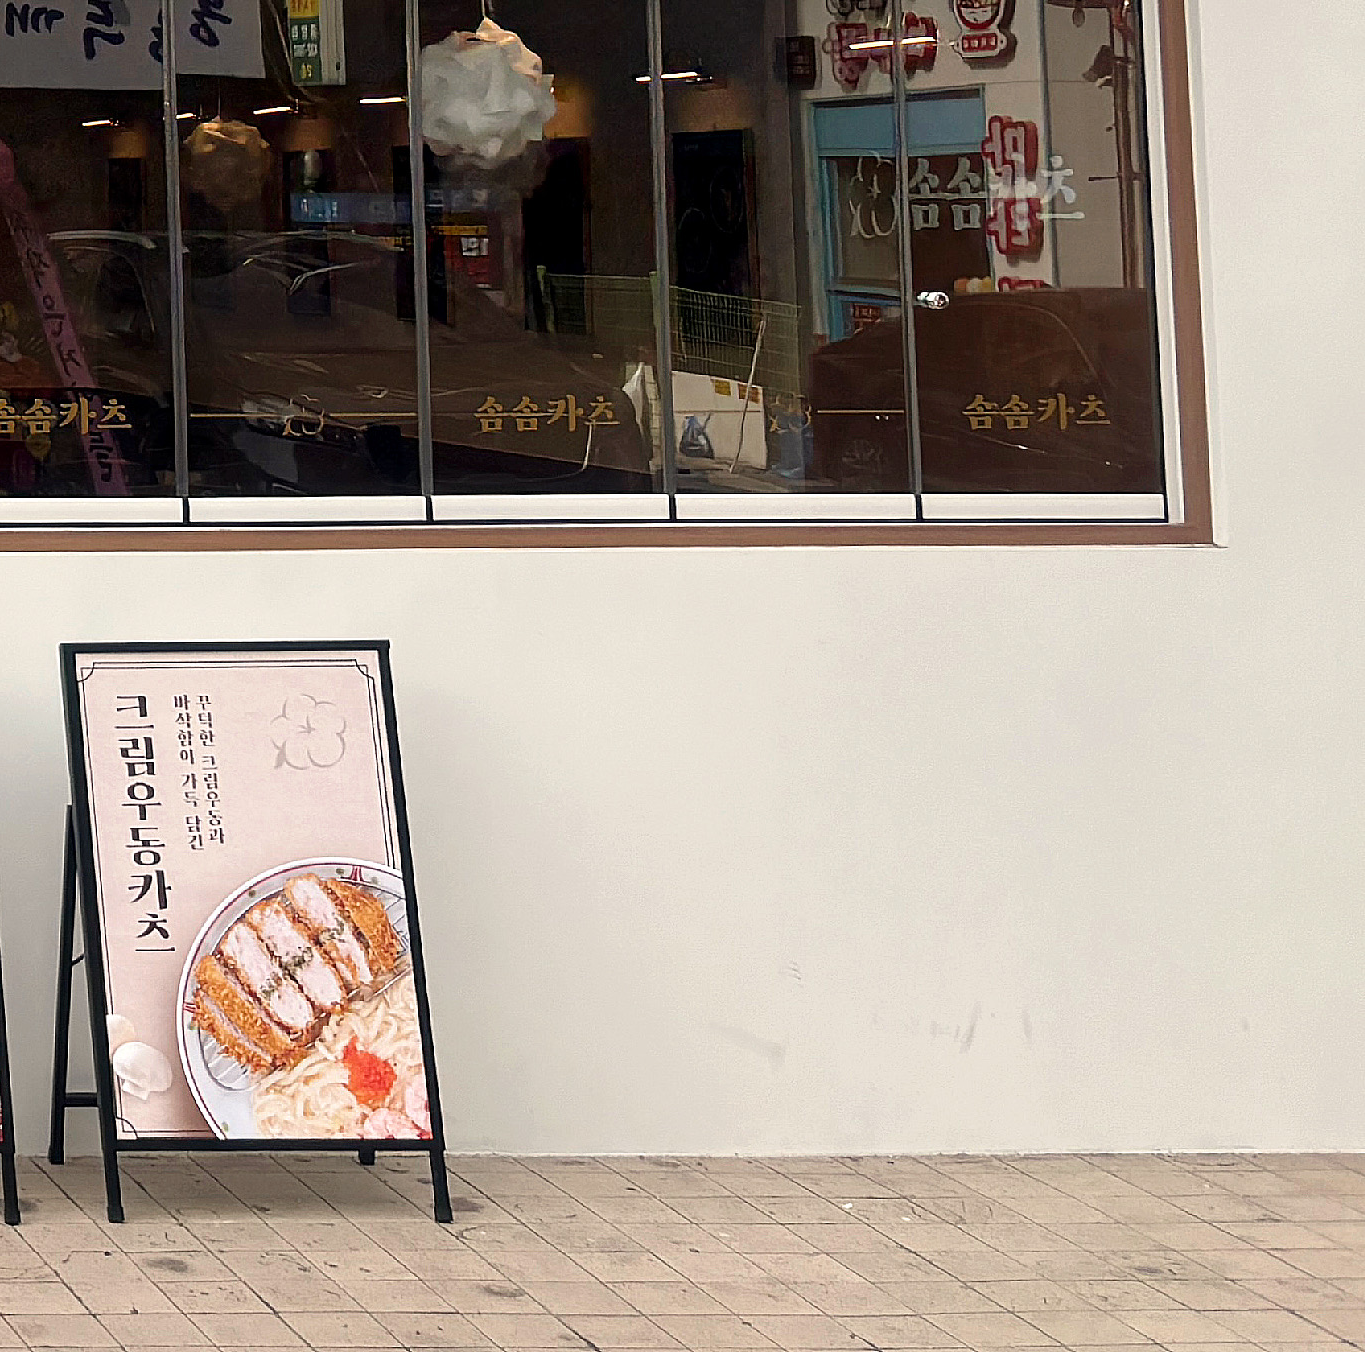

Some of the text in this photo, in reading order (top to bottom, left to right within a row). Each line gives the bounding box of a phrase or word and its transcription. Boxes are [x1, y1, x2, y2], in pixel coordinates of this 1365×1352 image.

[473, 394, 621, 433] 솜솜카츠
[961, 393, 1111, 430] 솜솜카츠
[115, 695, 176, 952] 크림우동카츠
[173, 694, 204, 851] 바삭함이 가득 담긴
[196, 695, 226, 846] 꾸덕한 크림우동과
